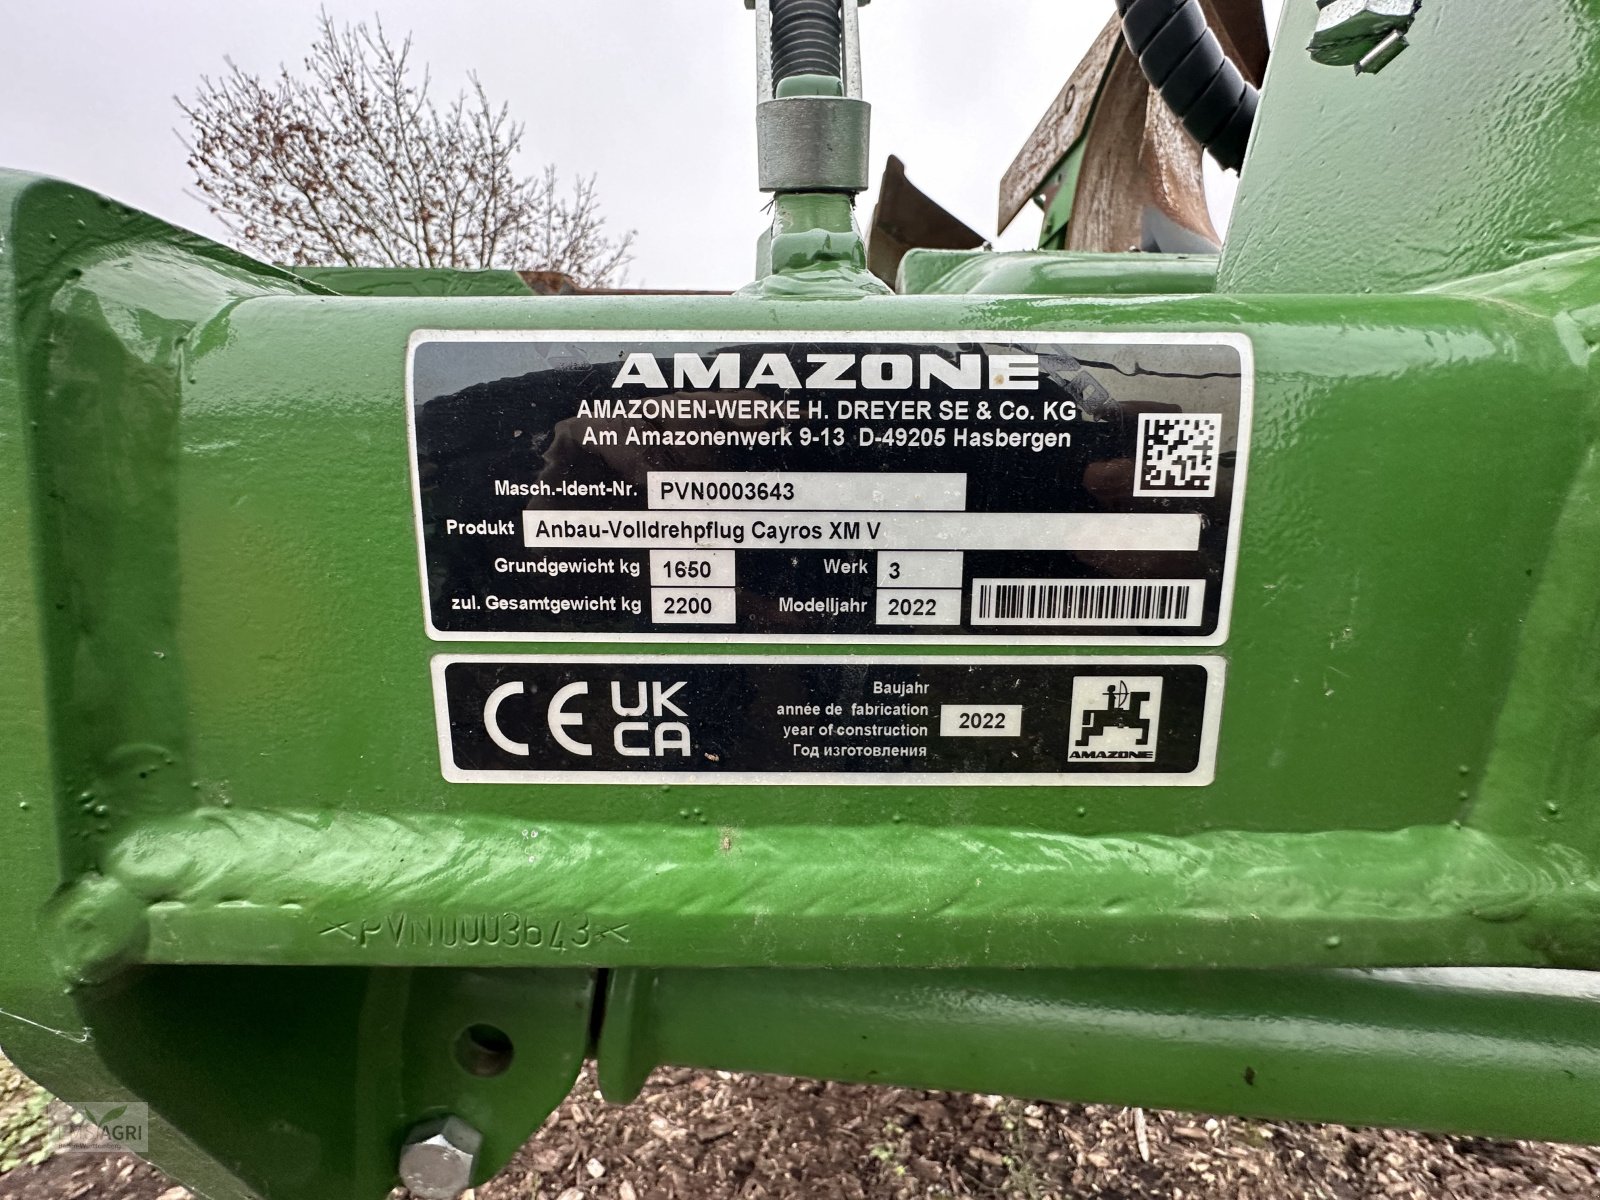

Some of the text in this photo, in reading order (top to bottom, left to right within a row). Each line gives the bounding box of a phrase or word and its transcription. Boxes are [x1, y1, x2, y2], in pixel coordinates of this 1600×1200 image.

[612, 353, 1039, 389] AMAZONE
[577, 399, 1077, 421] AMAZONEN-WERKE H. DREYER SE & Co. KG
[583, 427, 1071, 452] Am Amazonenwerk 9-13 D-49205 Hasbergen
[494, 480, 639, 497] Masch.-Ident-Nr.
[660, 482, 795, 501] PVN0003643
[447, 519, 515, 536] Produkt
[535, 520, 881, 543] Anbau-Volldrehpflug Cayros XM V
[494, 557, 641, 577] Grundgewicht kg
[663, 561, 712, 579] 1650
[823, 559, 868, 574] Werk
[888, 561, 901, 579] 3
[451, 596, 642, 615] zul. Gesamtgewicht kg
[663, 597, 713, 615] 2200
[778, 596, 868, 615] Modelljahr
[887, 598, 937, 616] 2022
[873, 681, 929, 697] Baujahr
[776, 702, 929, 716] année de fabrication
[958, 712, 1006, 729] 2022
[783, 724, 928, 738] year of construction
[793, 744, 927, 758] Год изготовления
[1069, 751, 1154, 759] AMAZONE
